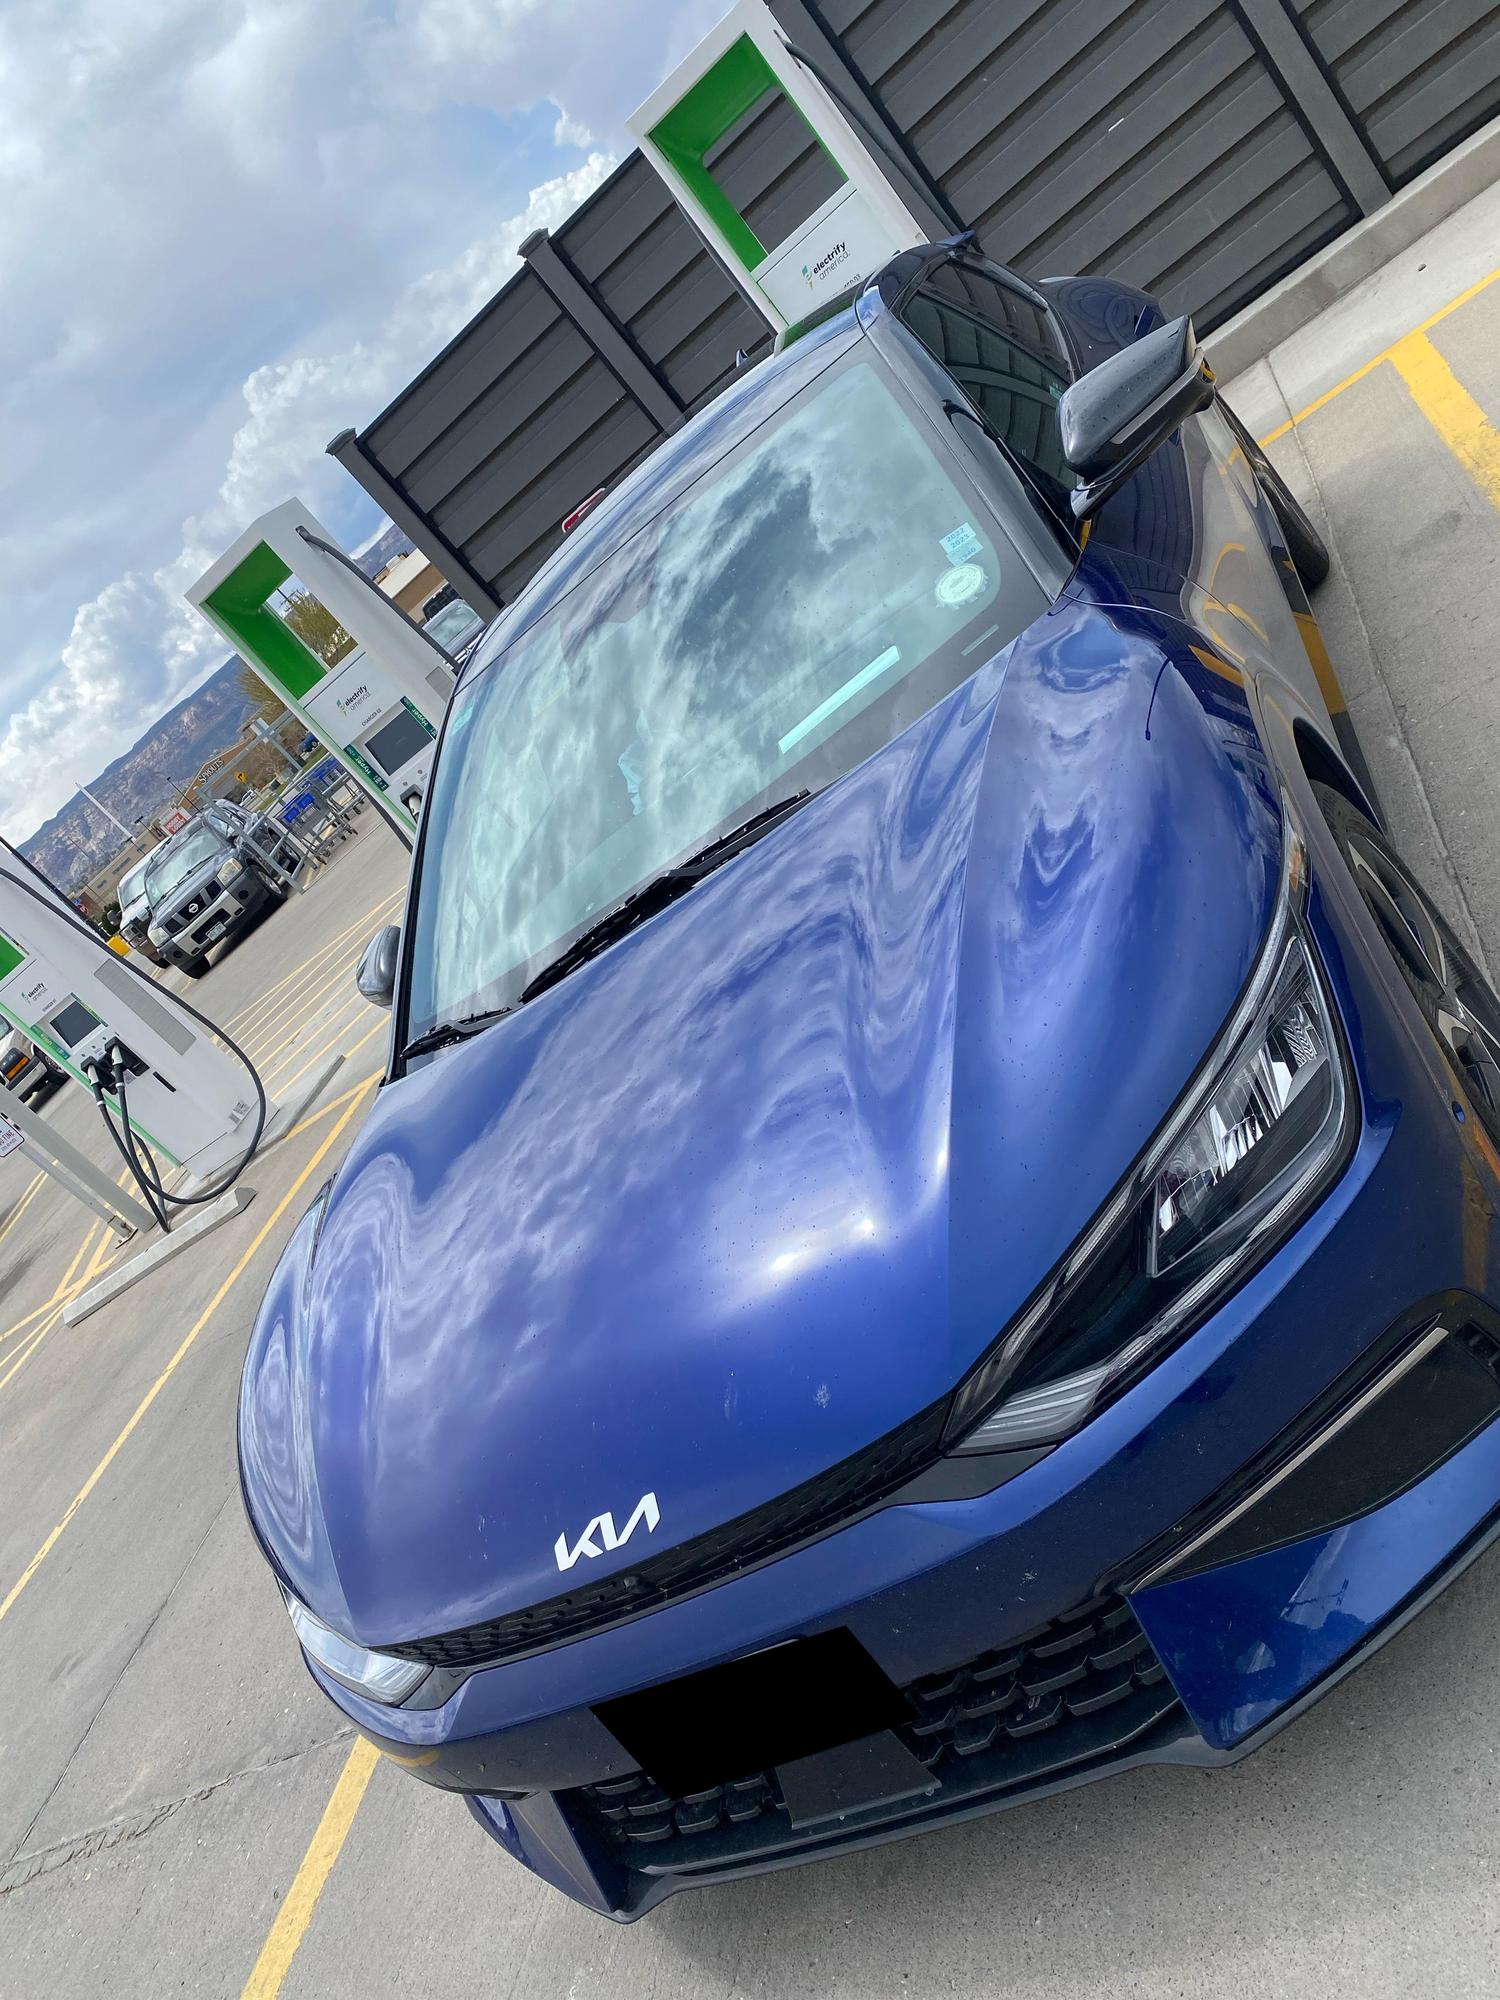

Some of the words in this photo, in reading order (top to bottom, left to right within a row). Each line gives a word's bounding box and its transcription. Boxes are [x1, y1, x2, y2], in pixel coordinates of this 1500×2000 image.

[813, 241, 846, 274] electrify
[345, 685, 368, 706] electrify
[412, 708, 429, 727] Hyper
[198, 758, 224, 785] SPROUTS
[355, 757, 371, 775] Hyper
[554, 1491, 661, 1571] KIA
